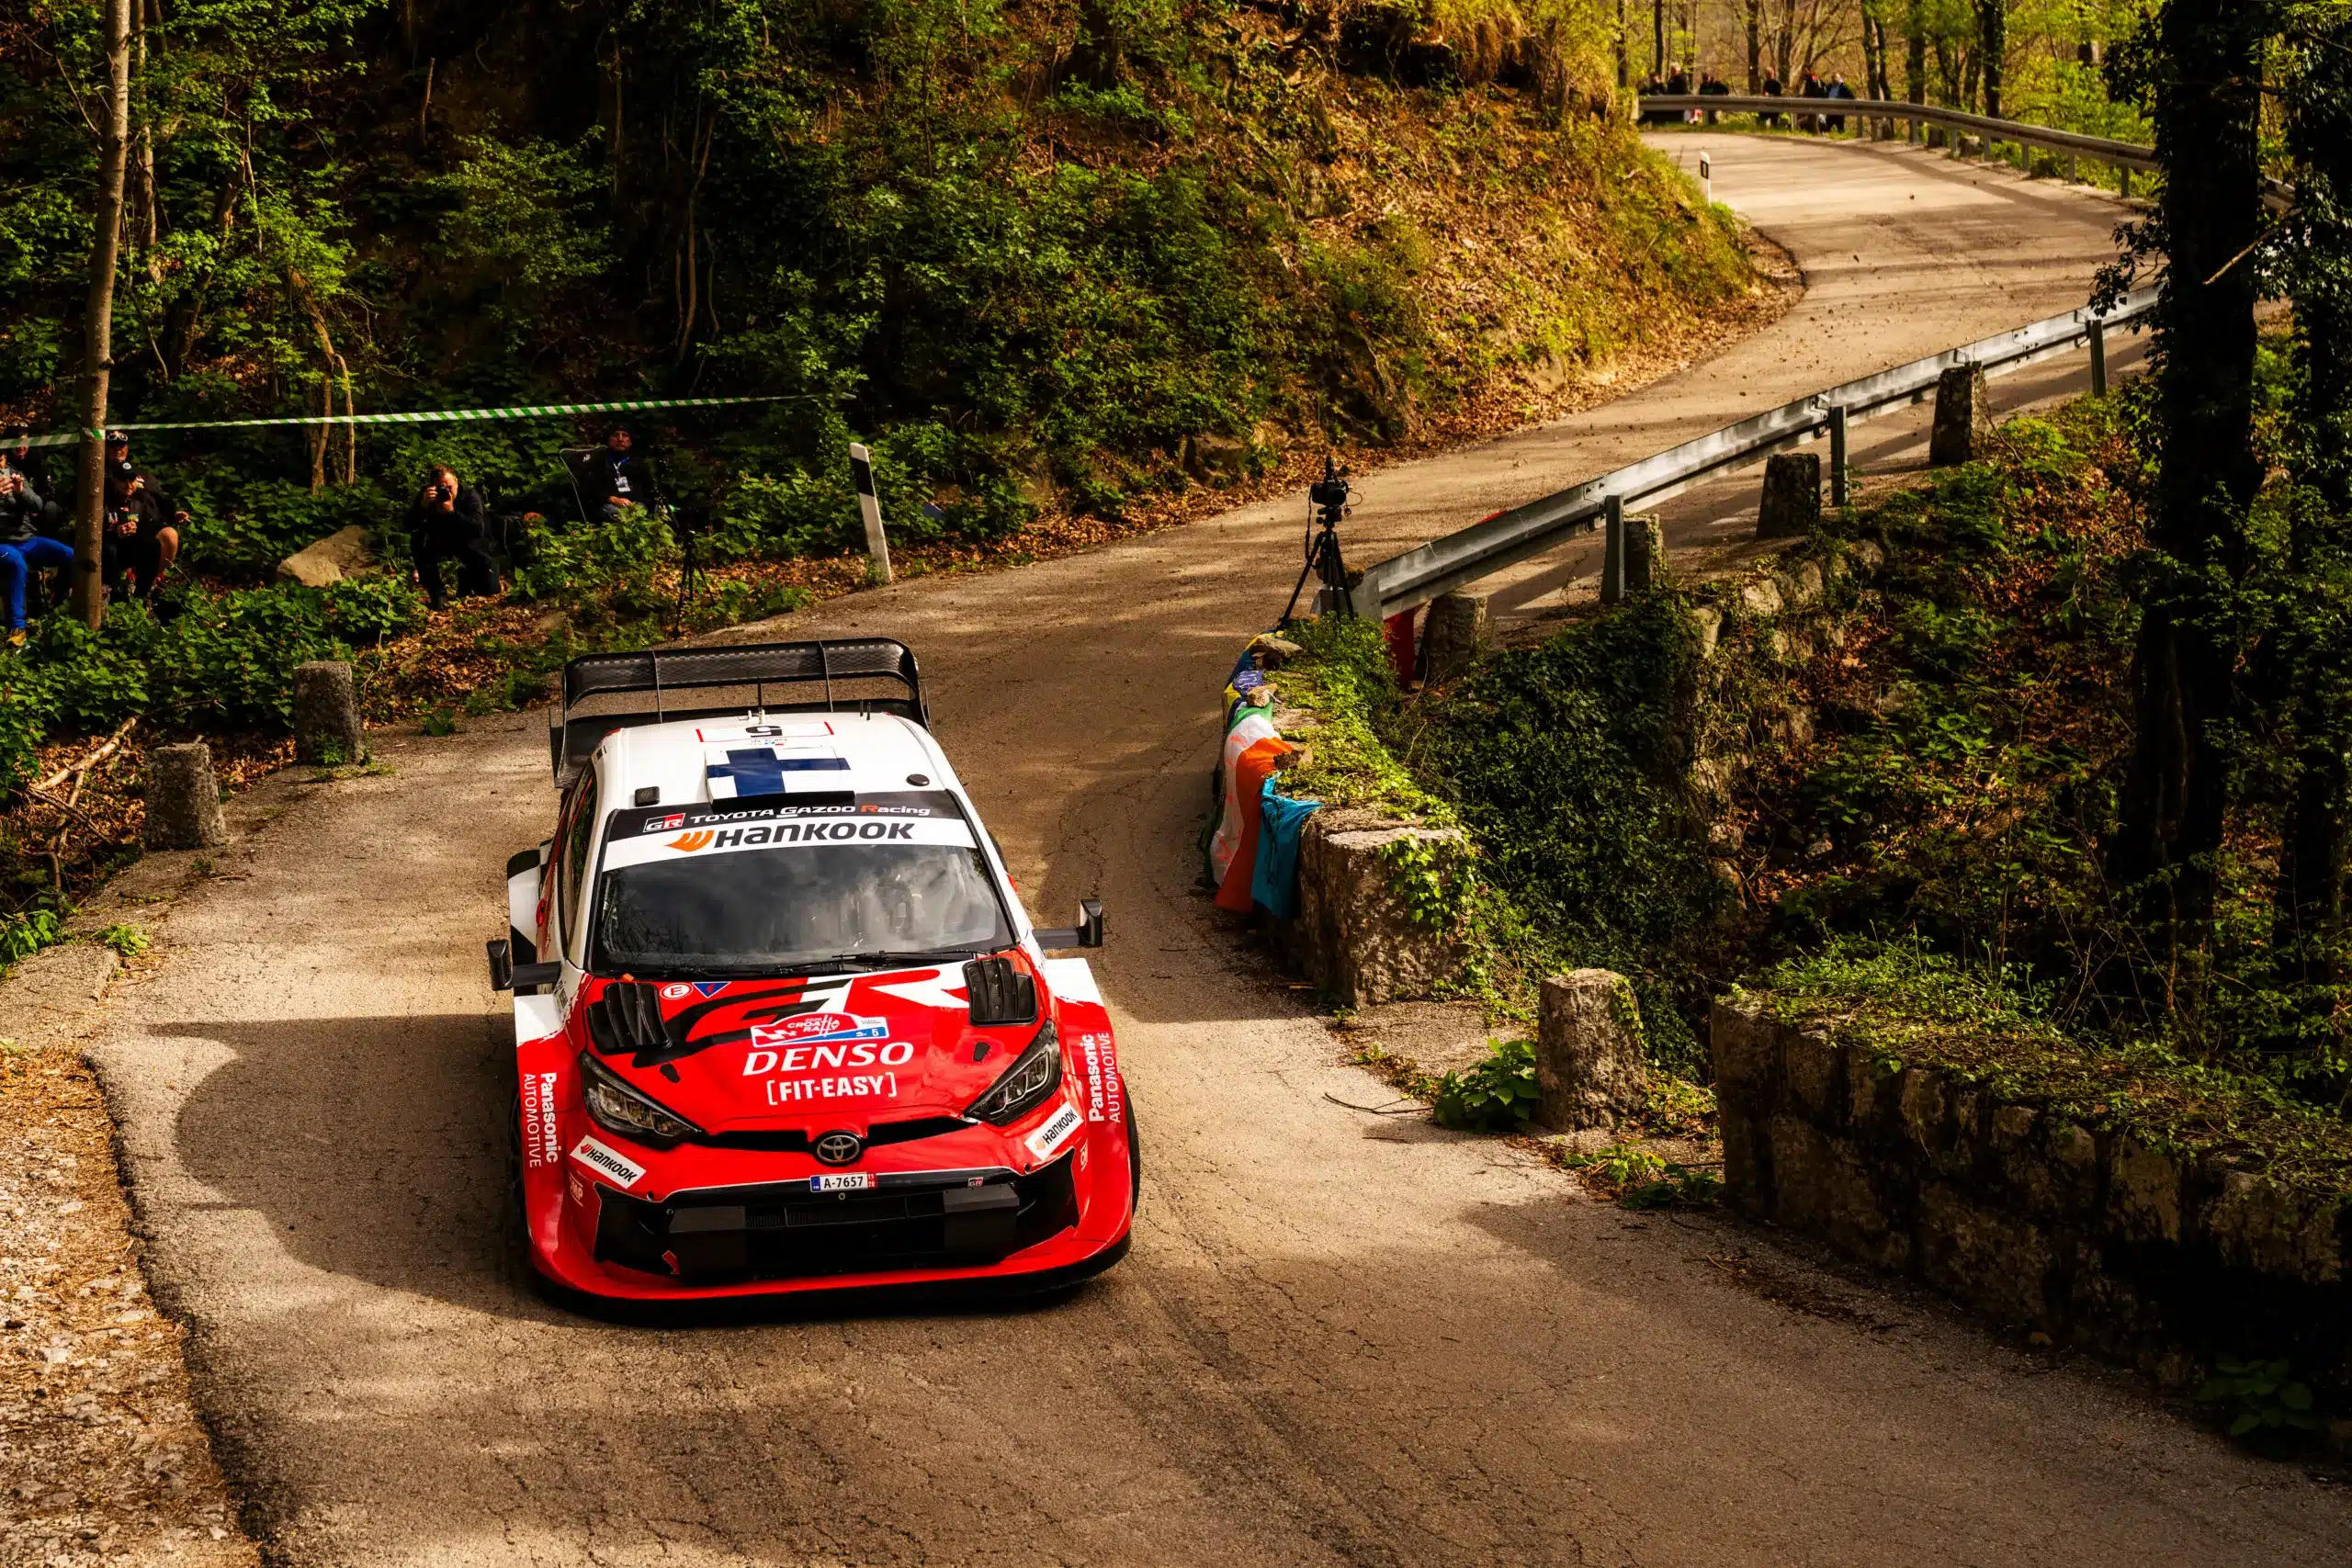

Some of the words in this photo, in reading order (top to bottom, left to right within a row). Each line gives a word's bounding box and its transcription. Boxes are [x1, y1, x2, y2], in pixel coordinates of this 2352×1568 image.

[647, 817, 682, 832] GR
[690, 808, 775, 824] TOYOTA
[777, 805, 855, 818] GAZOO
[861, 805, 931, 816] Racing
[670, 987, 683, 996] E
[742, 1042, 914, 1077] DENSO
[1080, 1033, 1104, 1122] Panasonic
[1097, 1032, 1122, 1123] AUTOMOTIVE
[524, 1073, 542, 1168] AUTOMOTIVE
[540, 1072, 562, 1163] Panasonic
[823, 1176, 864, 1189] A-7657
